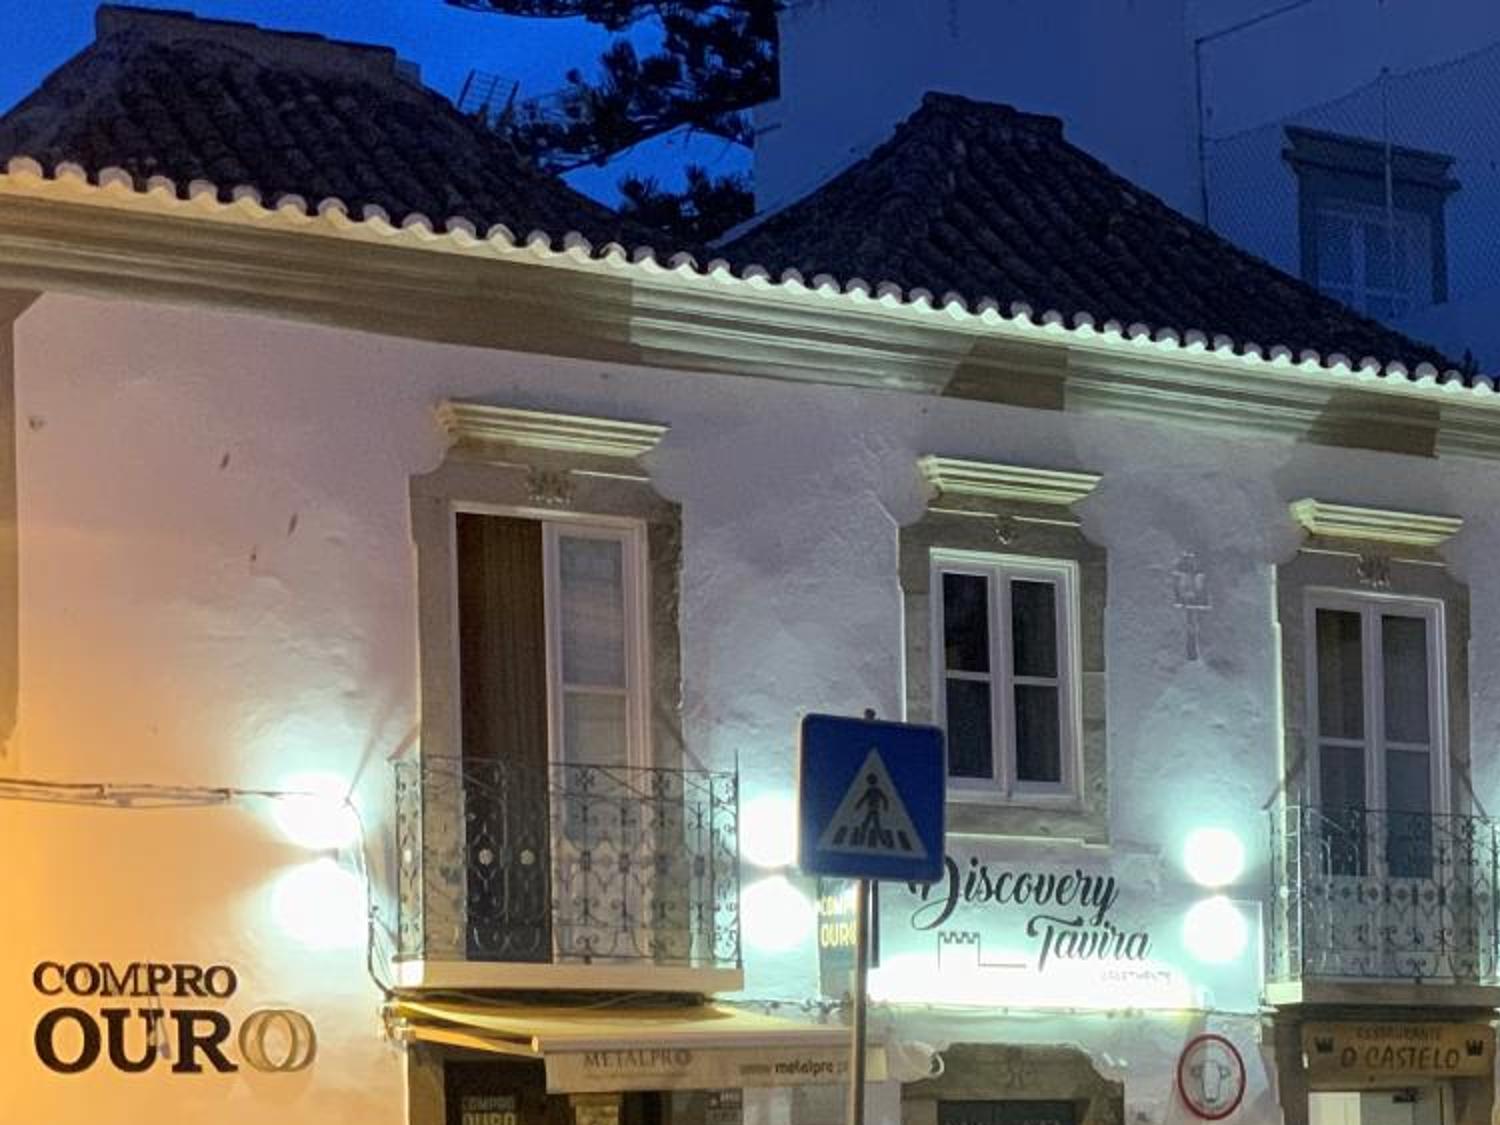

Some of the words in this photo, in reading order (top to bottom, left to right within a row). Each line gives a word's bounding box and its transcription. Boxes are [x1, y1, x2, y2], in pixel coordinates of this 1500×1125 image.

[908, 856, 1120, 927] Discovery
[1026, 914, 1153, 972] Tavira
[32, 960, 238, 999] COMPRO
[34, 1006, 318, 1074] OURO
[583, 1049, 694, 1068] METALPRO
[1366, 1045, 1460, 1071] CASTELO
